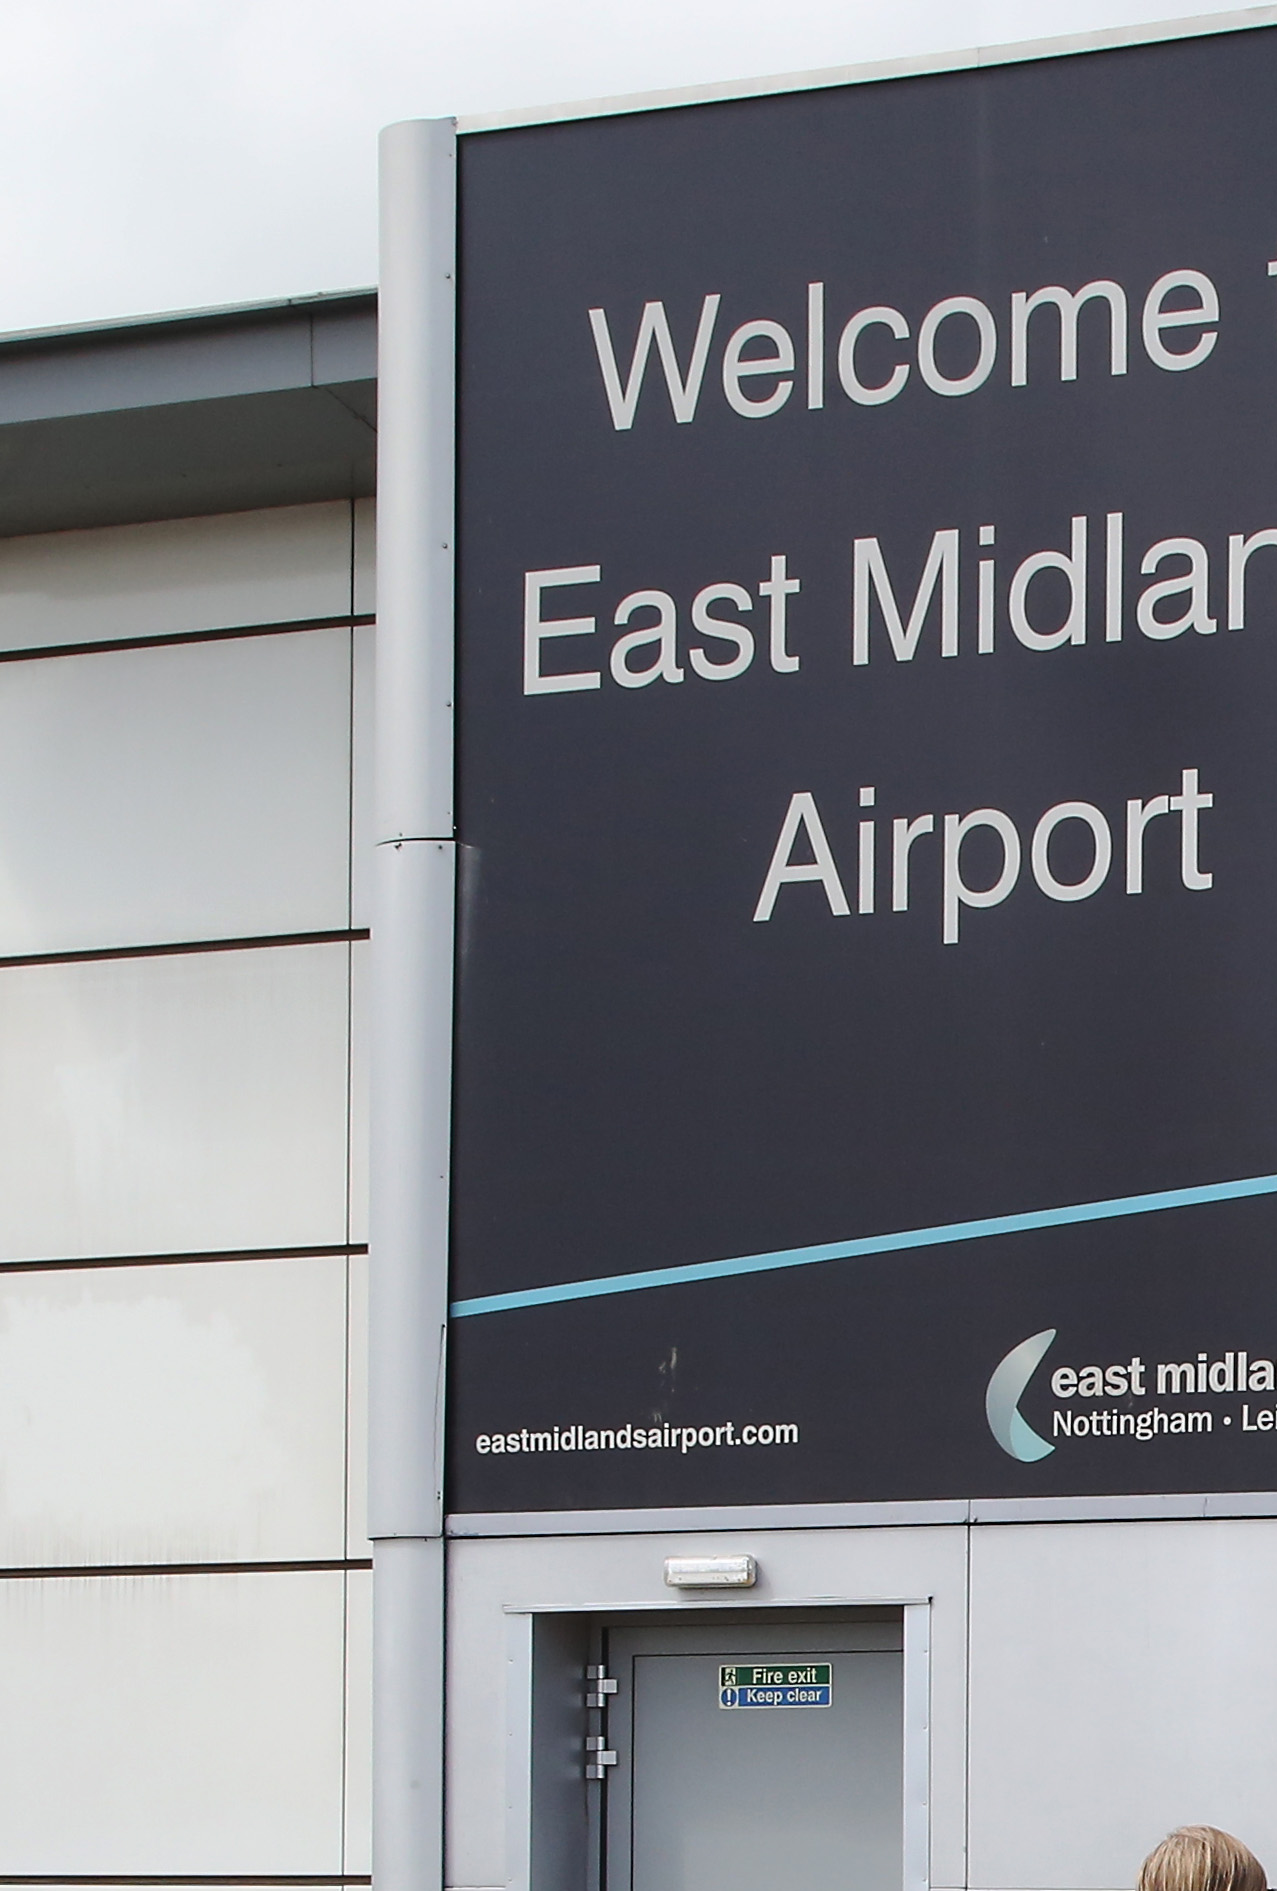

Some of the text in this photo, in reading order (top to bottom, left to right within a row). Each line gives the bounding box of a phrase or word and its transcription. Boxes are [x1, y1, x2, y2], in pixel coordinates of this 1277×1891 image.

[588, 270, 1220, 431] Welcome
[523, 555, 801, 696] East
[752, 768, 1214, 945] Airport
[1051, 1356, 1146, 1398] east
[475, 1421, 799, 1454] eastmidlandsairport.com
[1052, 1407, 1213, 1440] Nottingham
[752, 1667, 817, 1684] Fire exit
[747, 1688, 822, 1706] Keep clear
